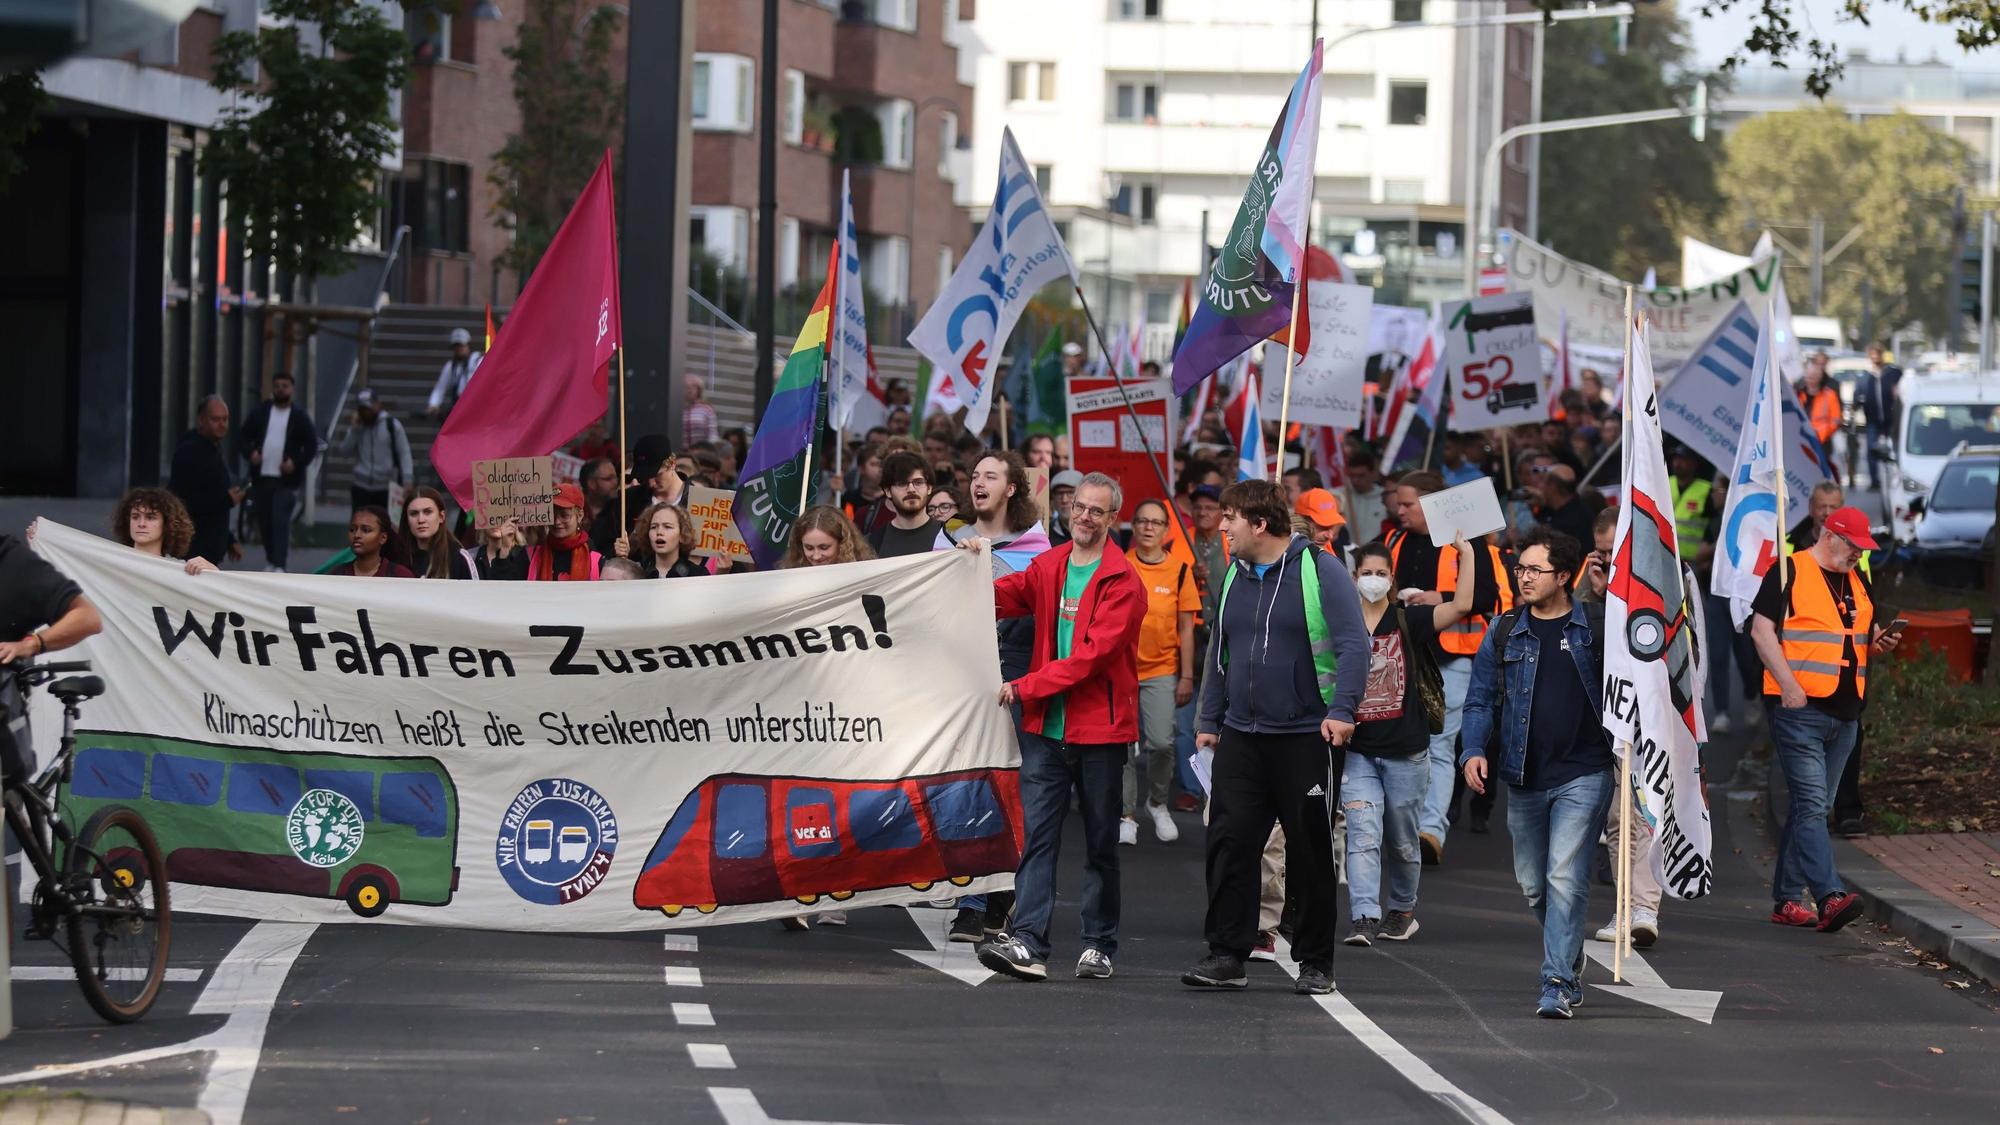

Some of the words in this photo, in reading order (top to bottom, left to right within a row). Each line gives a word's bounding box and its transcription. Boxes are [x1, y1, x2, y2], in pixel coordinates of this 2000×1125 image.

[1102, 389, 1155, 405] KLIMKARTE
[1462, 354, 1514, 400] 52
[476, 458, 541, 486] Solidarisch
[152, 606, 279, 667] Wir
[286, 606, 516, 678] Fahren
[529, 594, 893, 676] Zusammen!
[203, 692, 384, 745] Klimaschützen
[395, 709, 466, 748] heißt
[484, 710, 525, 747] die
[538, 705, 711, 746] Streikenden
[725, 700, 883, 744] unterstützen
[290, 803, 311, 853] FRIDAYS
[307, 791, 336, 808] FOR
[337, 798, 362, 856] FUTURE
[504, 783, 544, 830] FAHREN
[551, 779, 617, 844] ZUSAMMEN
[310, 850, 337, 865] Köln
[498, 836, 515, 867] WIR
[560, 852, 610, 900] TVN24
